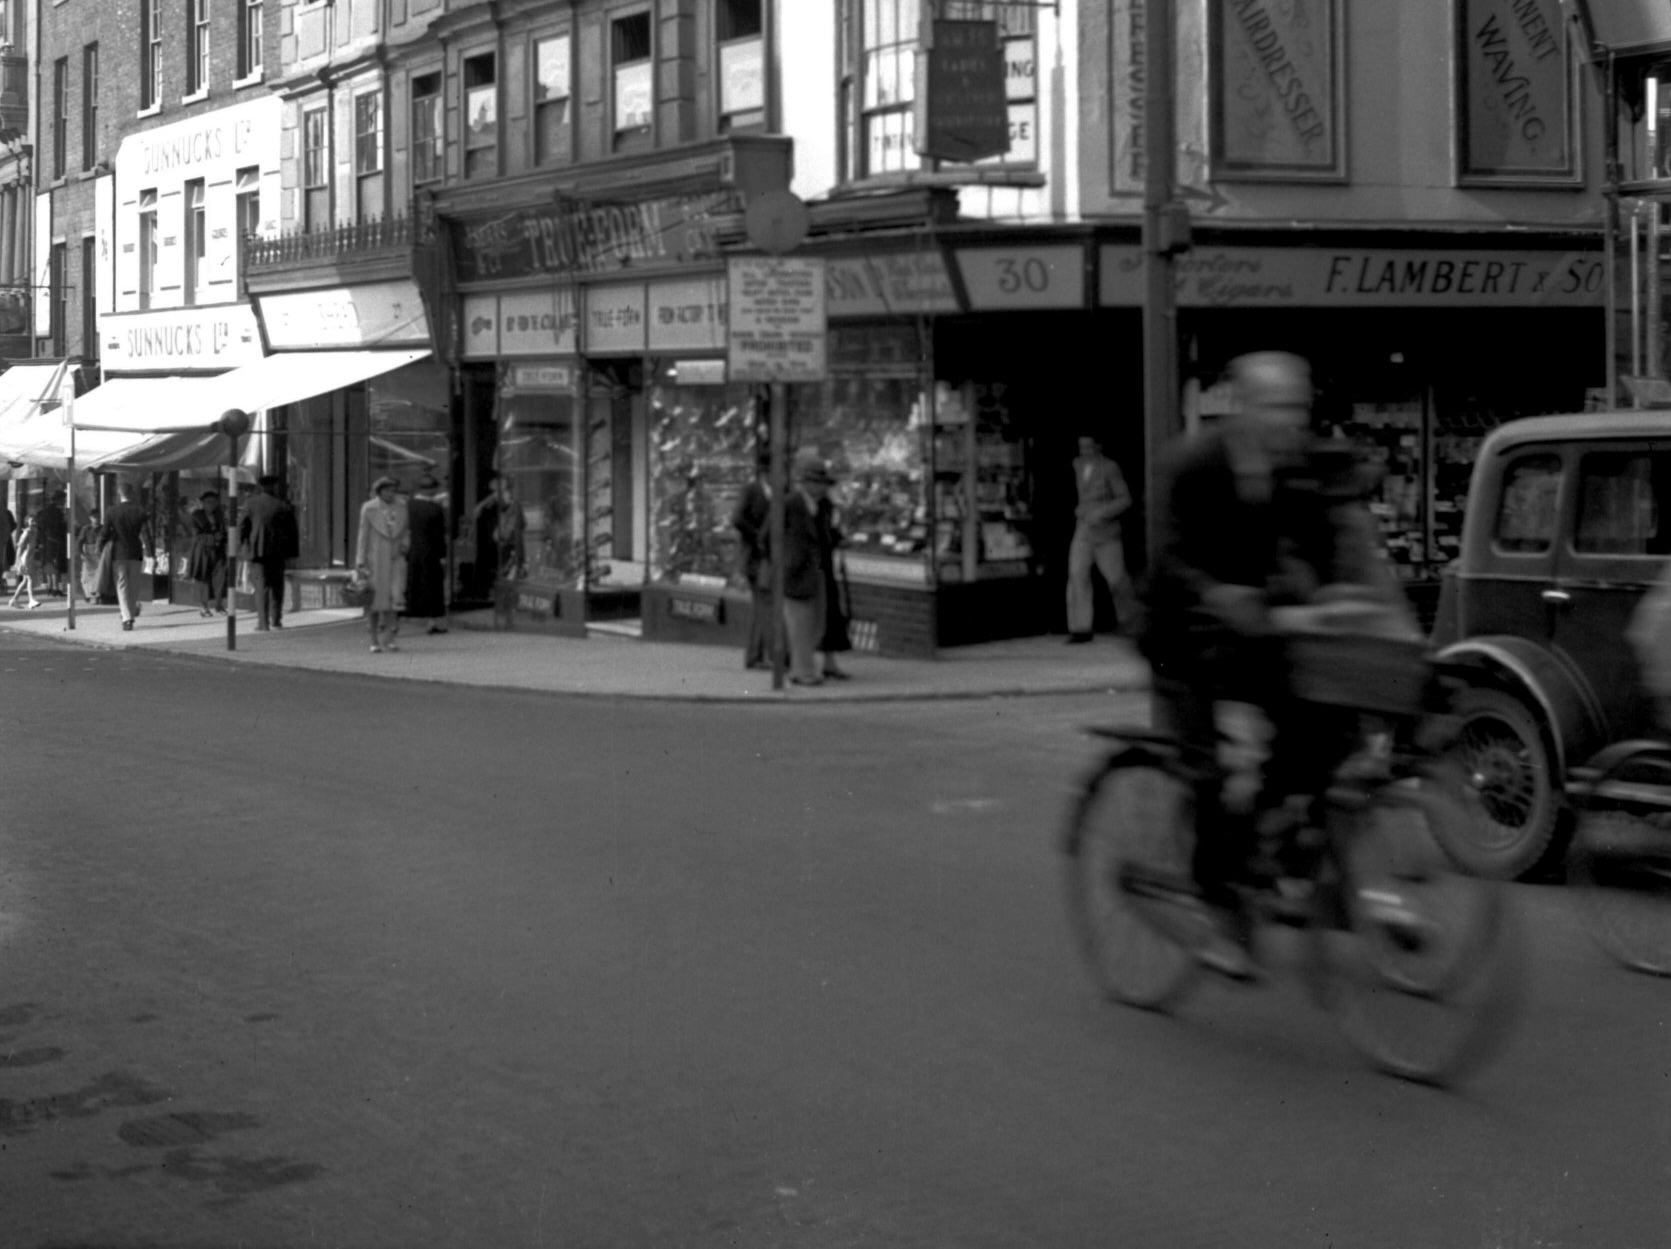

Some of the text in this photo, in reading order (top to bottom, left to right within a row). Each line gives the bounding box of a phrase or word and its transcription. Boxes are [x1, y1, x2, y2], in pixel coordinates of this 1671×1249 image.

[1476, 14, 1546, 154] WAVING.
[144, 128, 222, 175] SUNNUCKS
[995, 257, 1049, 293] 30
[1356, 256, 1528, 293] LAMBERT
[1562, 259, 1605, 294] SO
[128, 323, 202, 358] SUNNUCKS
